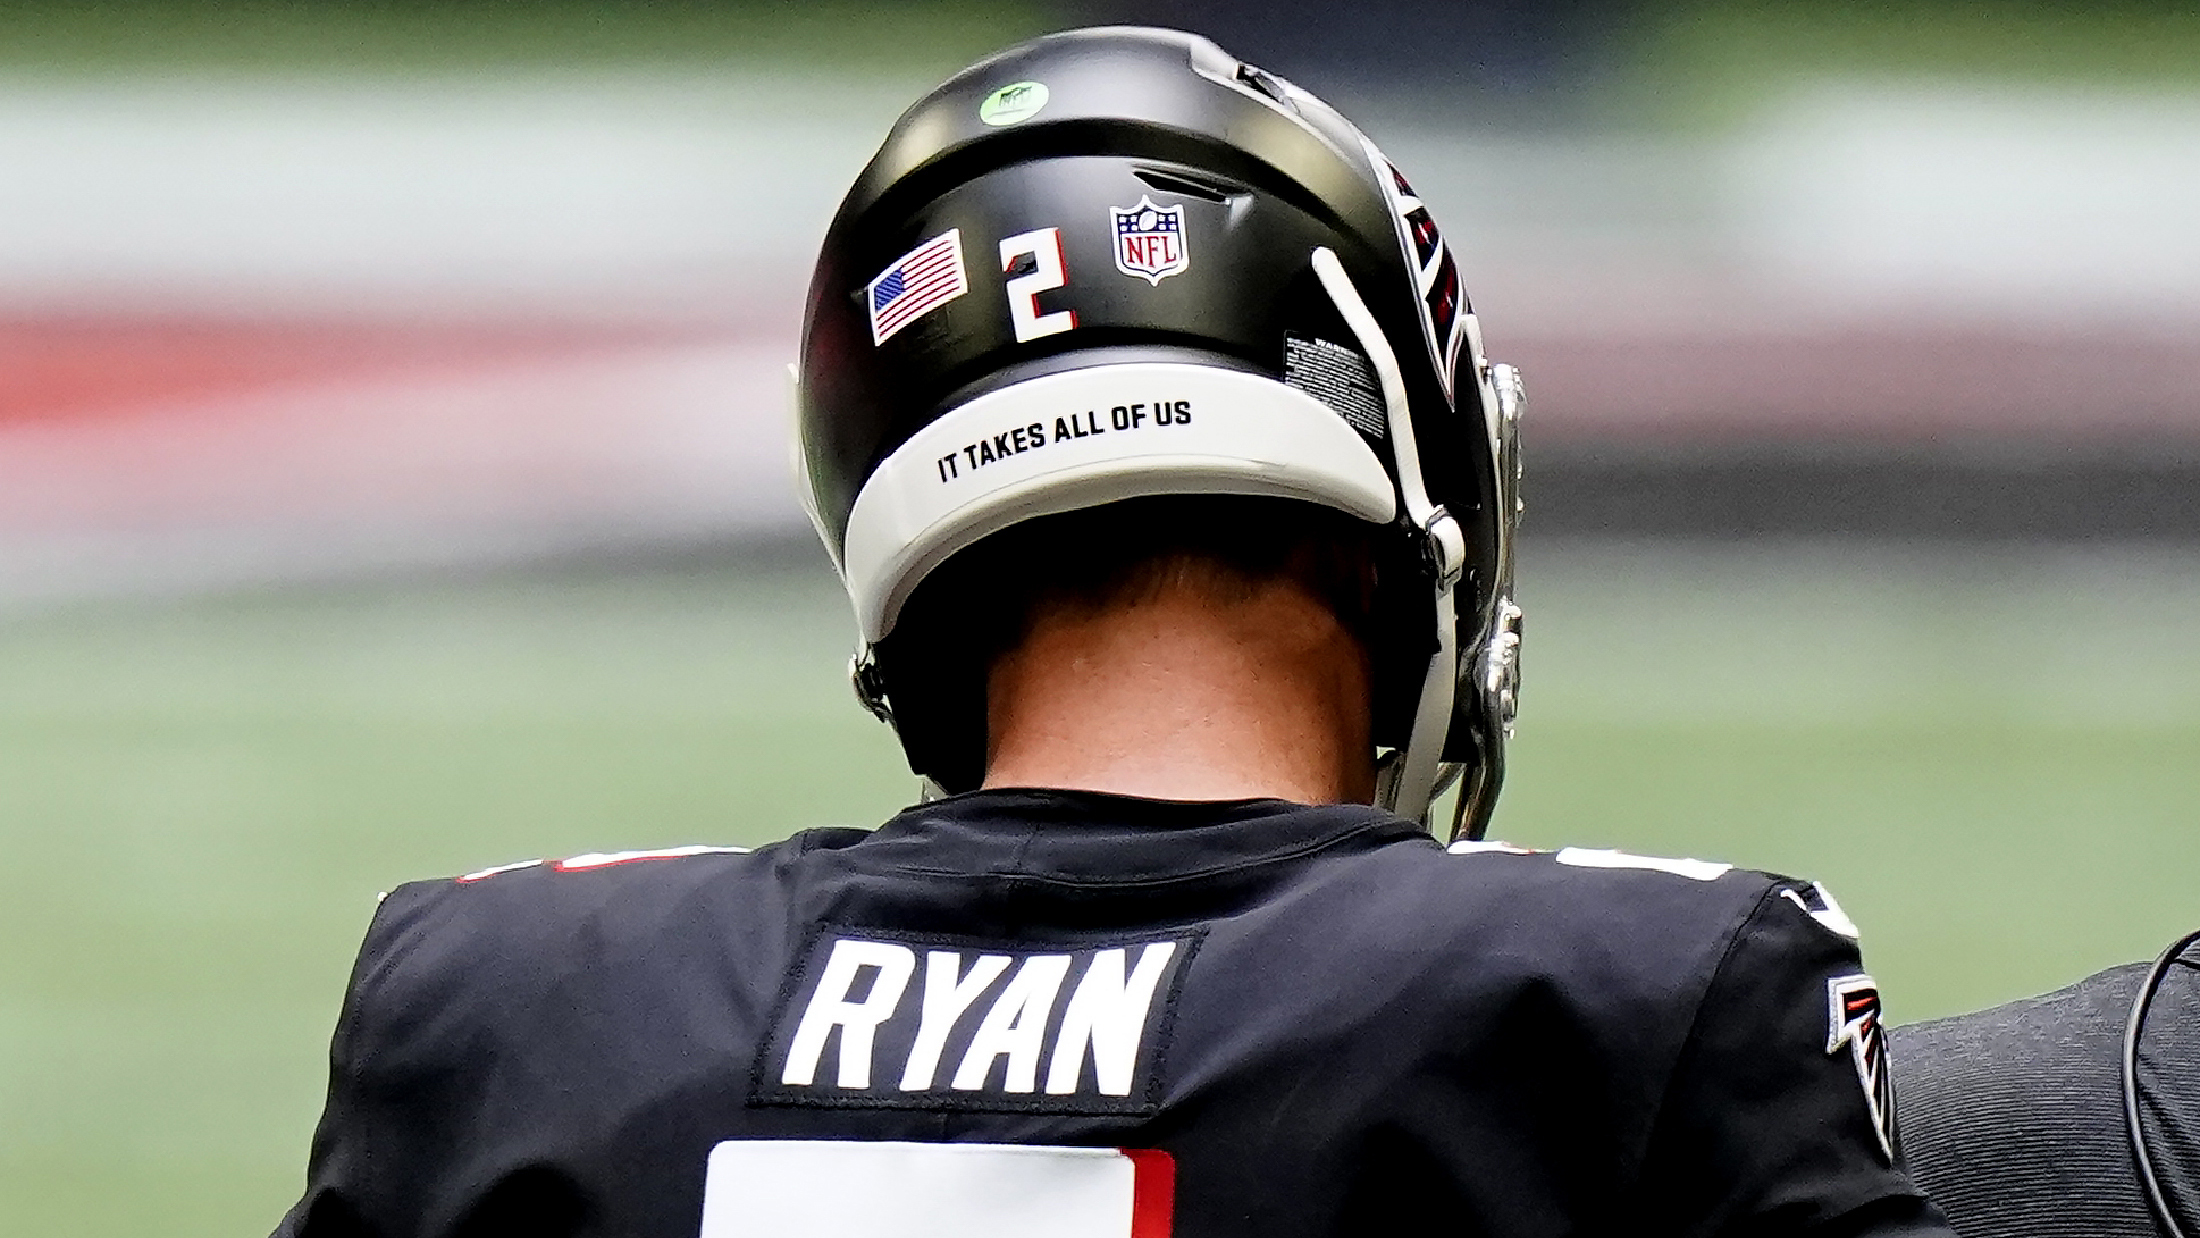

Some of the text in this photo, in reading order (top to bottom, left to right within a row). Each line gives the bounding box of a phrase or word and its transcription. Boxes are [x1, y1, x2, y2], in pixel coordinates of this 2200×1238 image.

[999, 227, 1079, 343] 2
[1125, 236, 1176, 268] NFL
[937, 401, 1191, 483] IT TAKES ALL OF US
[782, 939, 1176, 1096] RYAN
